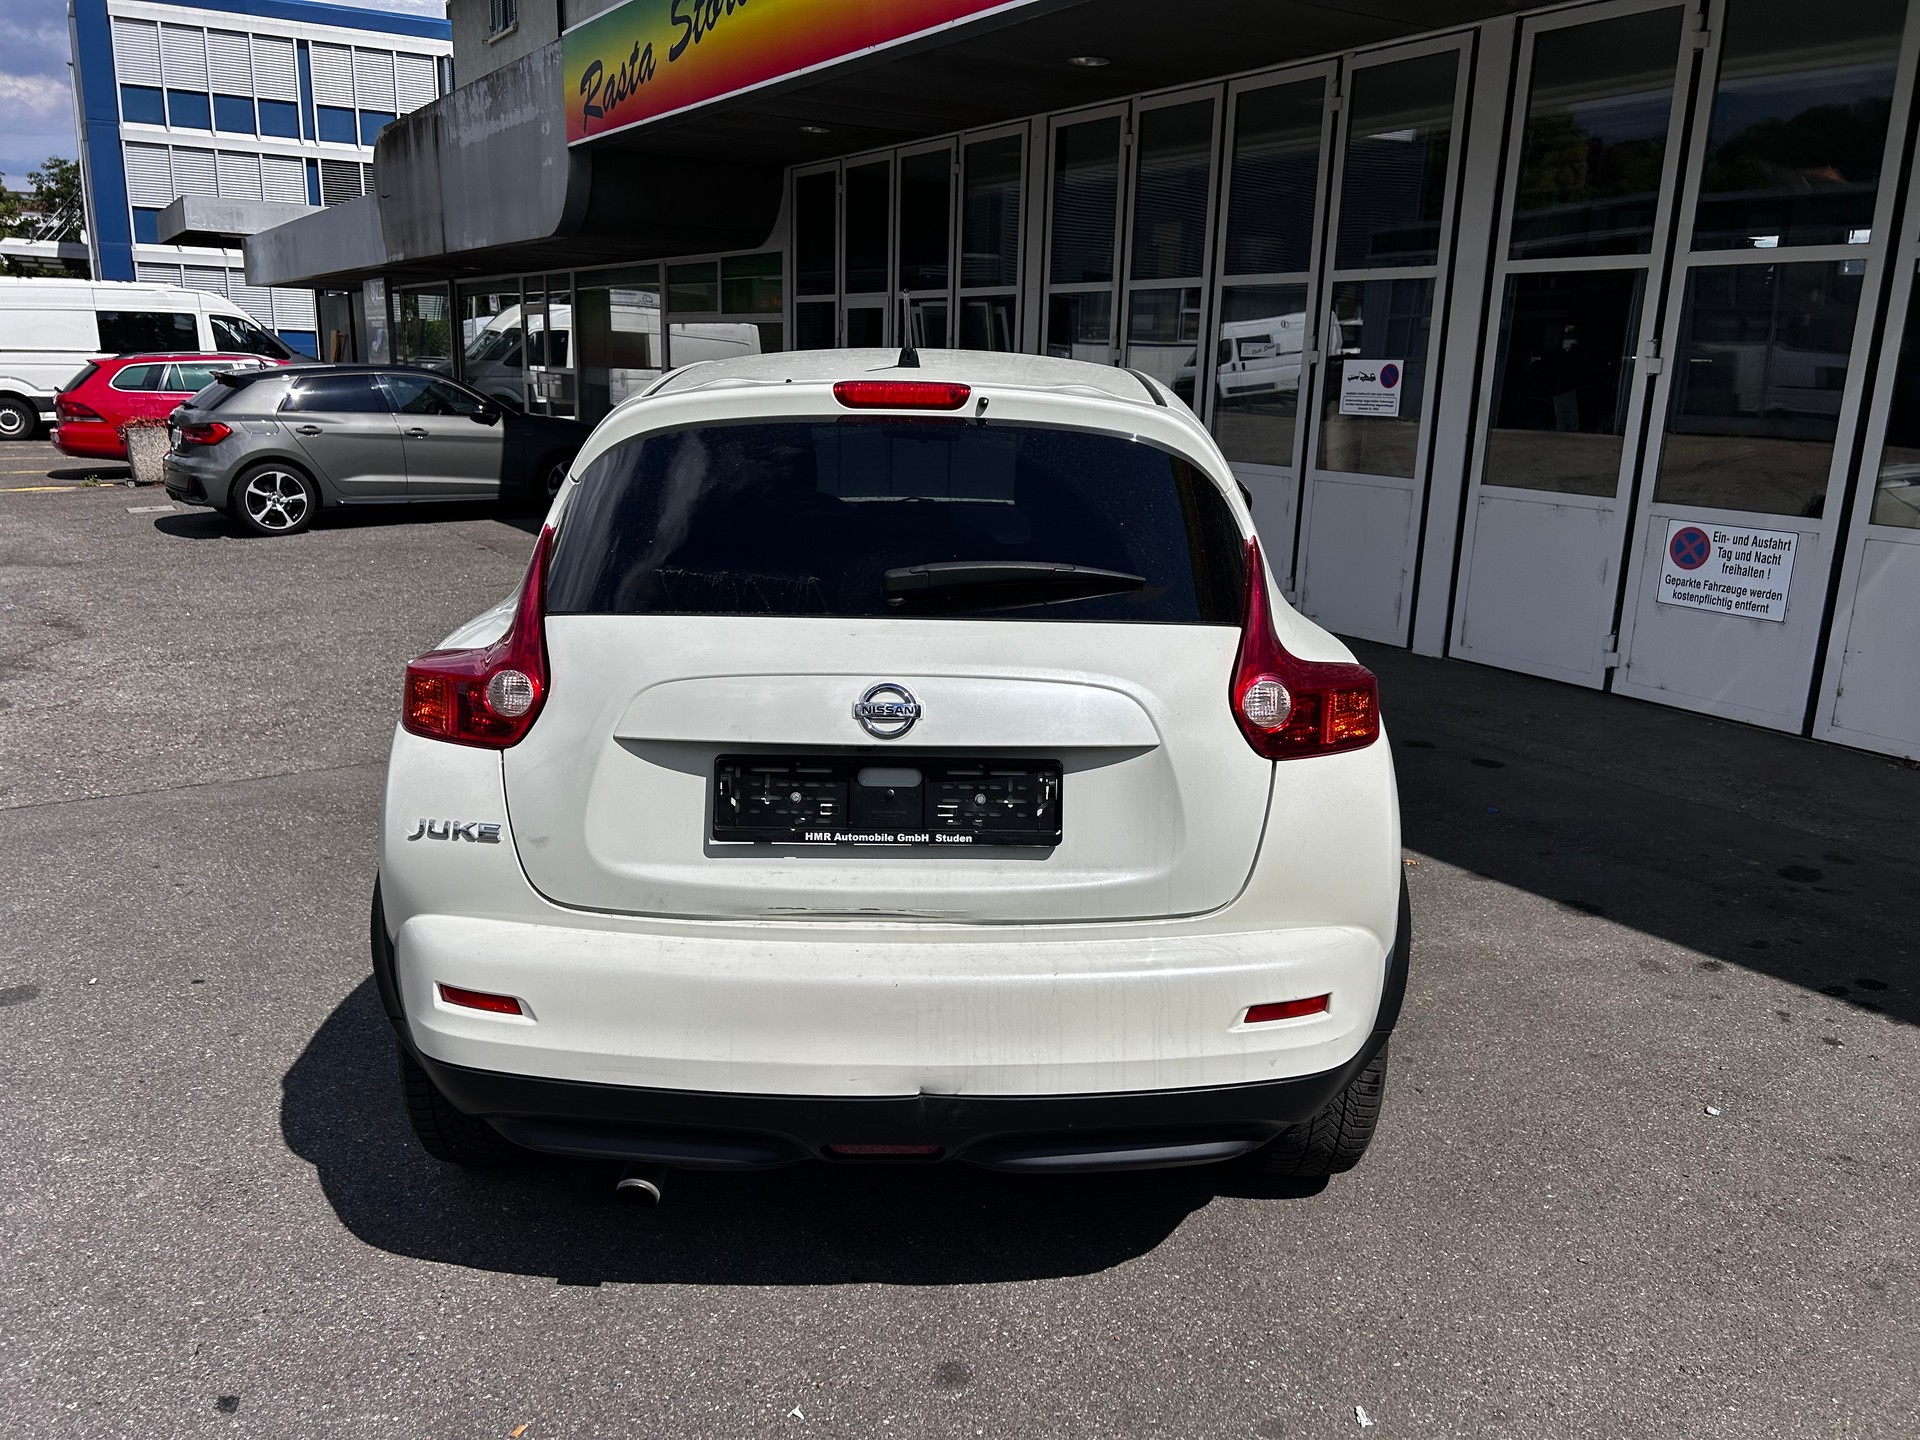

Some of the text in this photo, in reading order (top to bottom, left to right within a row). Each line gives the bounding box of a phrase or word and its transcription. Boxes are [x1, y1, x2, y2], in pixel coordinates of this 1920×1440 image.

[580, 40, 656, 133] Rasta
[1712, 531, 1792, 551] Ein- und Ausfahrt
[1718, 546, 1782, 566] Tag und Nacht
[1721, 562, 1765, 580] freihalten
[1665, 574, 1783, 601] Geparkte Fahrzeuge werden
[1672, 589, 1770, 614] kostenpflichtig entfernt
[861, 705, 915, 715] NISSAN
[407, 818, 502, 844] JUKE
[805, 832, 973, 843] HMR Automobile GmbH Studen
